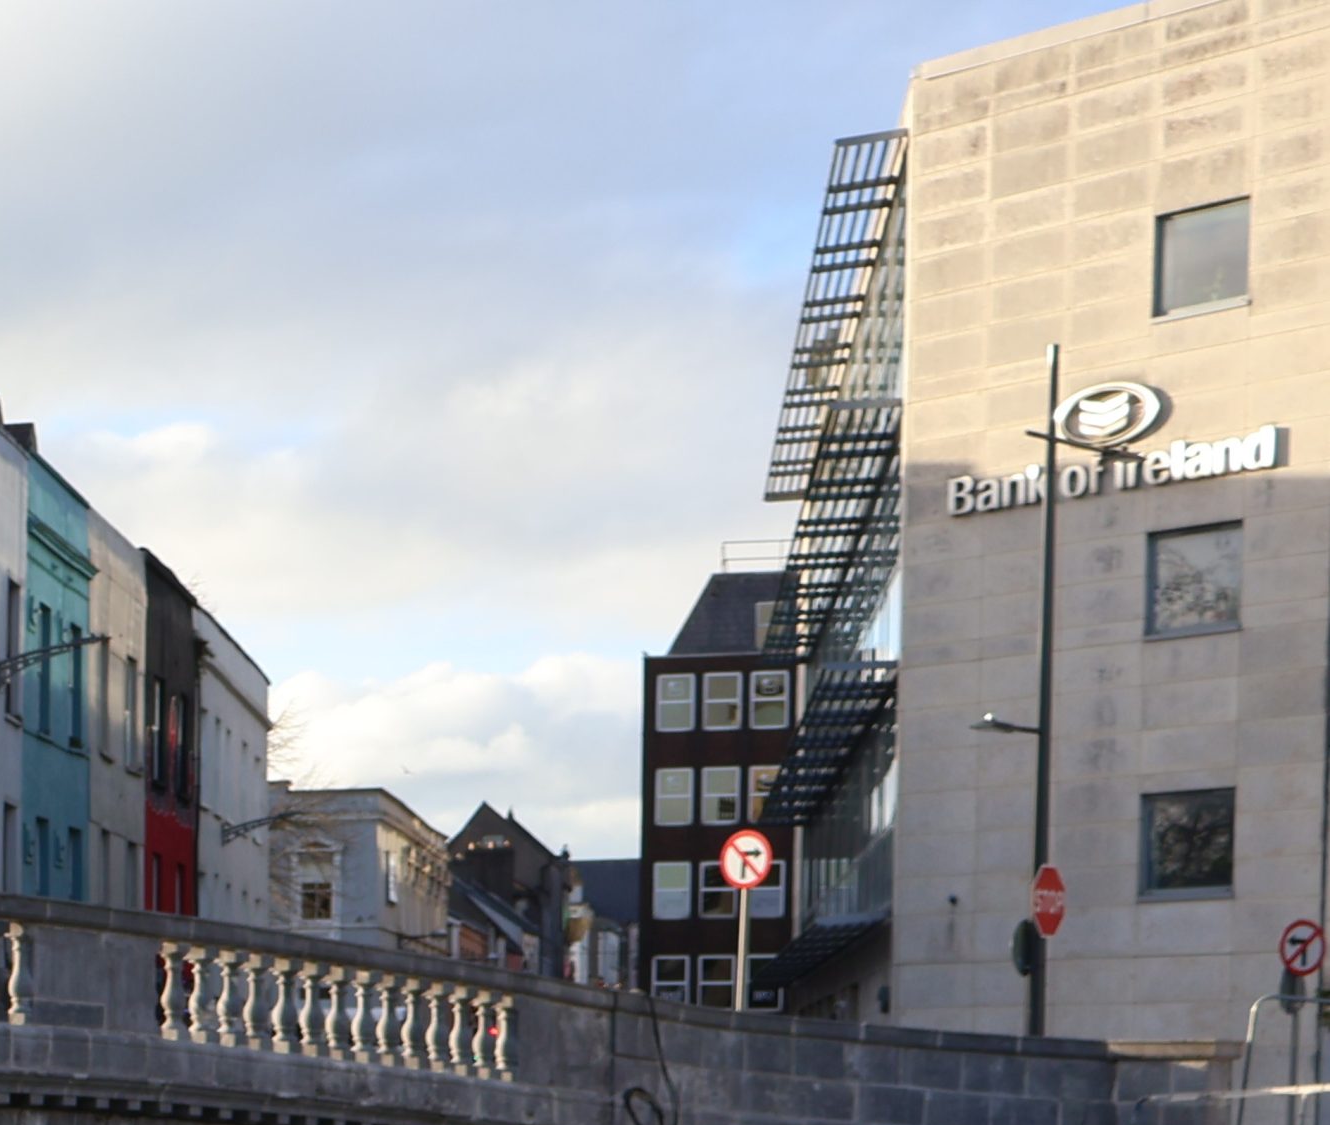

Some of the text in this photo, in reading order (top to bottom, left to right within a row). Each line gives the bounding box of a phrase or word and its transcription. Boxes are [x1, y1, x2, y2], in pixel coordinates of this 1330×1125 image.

[947, 424, 1277, 516] Bank of Ireland
